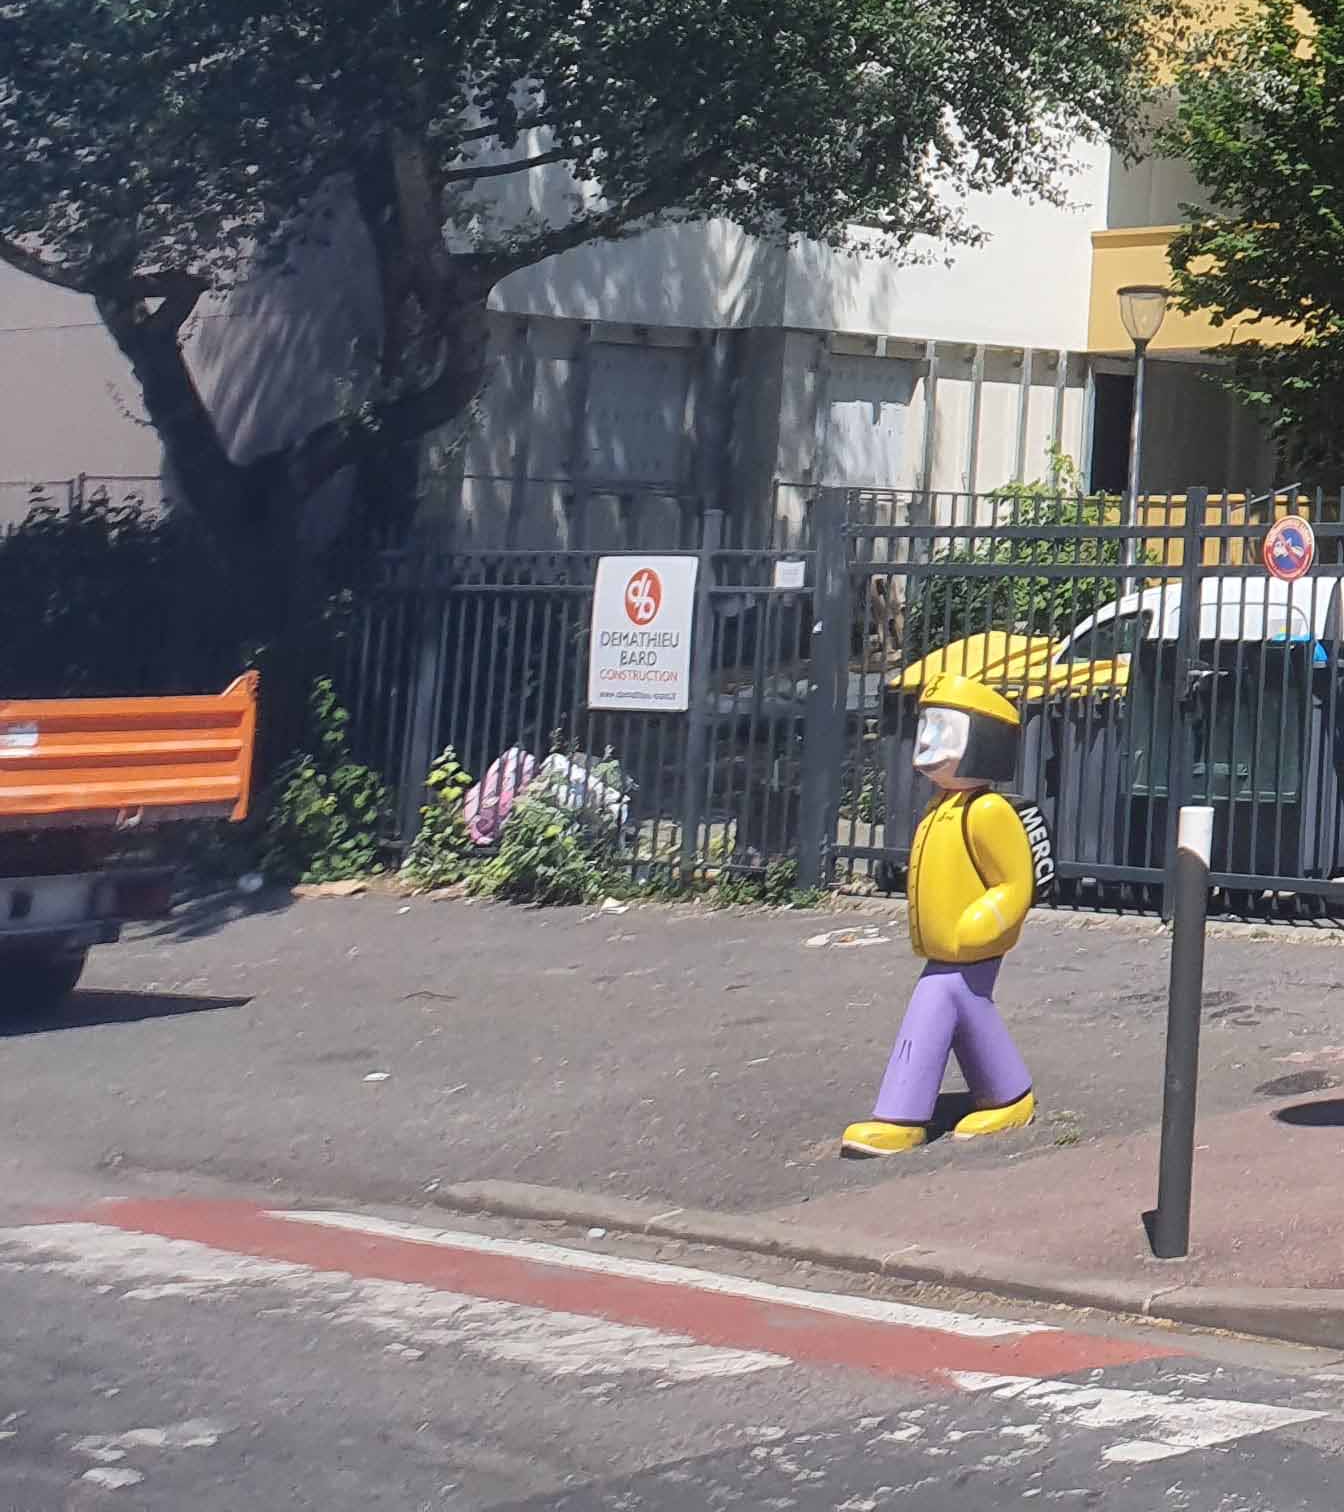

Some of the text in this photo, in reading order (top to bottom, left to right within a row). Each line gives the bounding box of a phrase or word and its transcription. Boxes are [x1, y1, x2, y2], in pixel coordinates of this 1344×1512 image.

[600, 631, 679, 648] DEMATHIEU
[620, 651, 657, 666] BARD
[600, 669, 679, 681] CONSTRUCTION
[1018, 806, 1056, 887] MERCI
